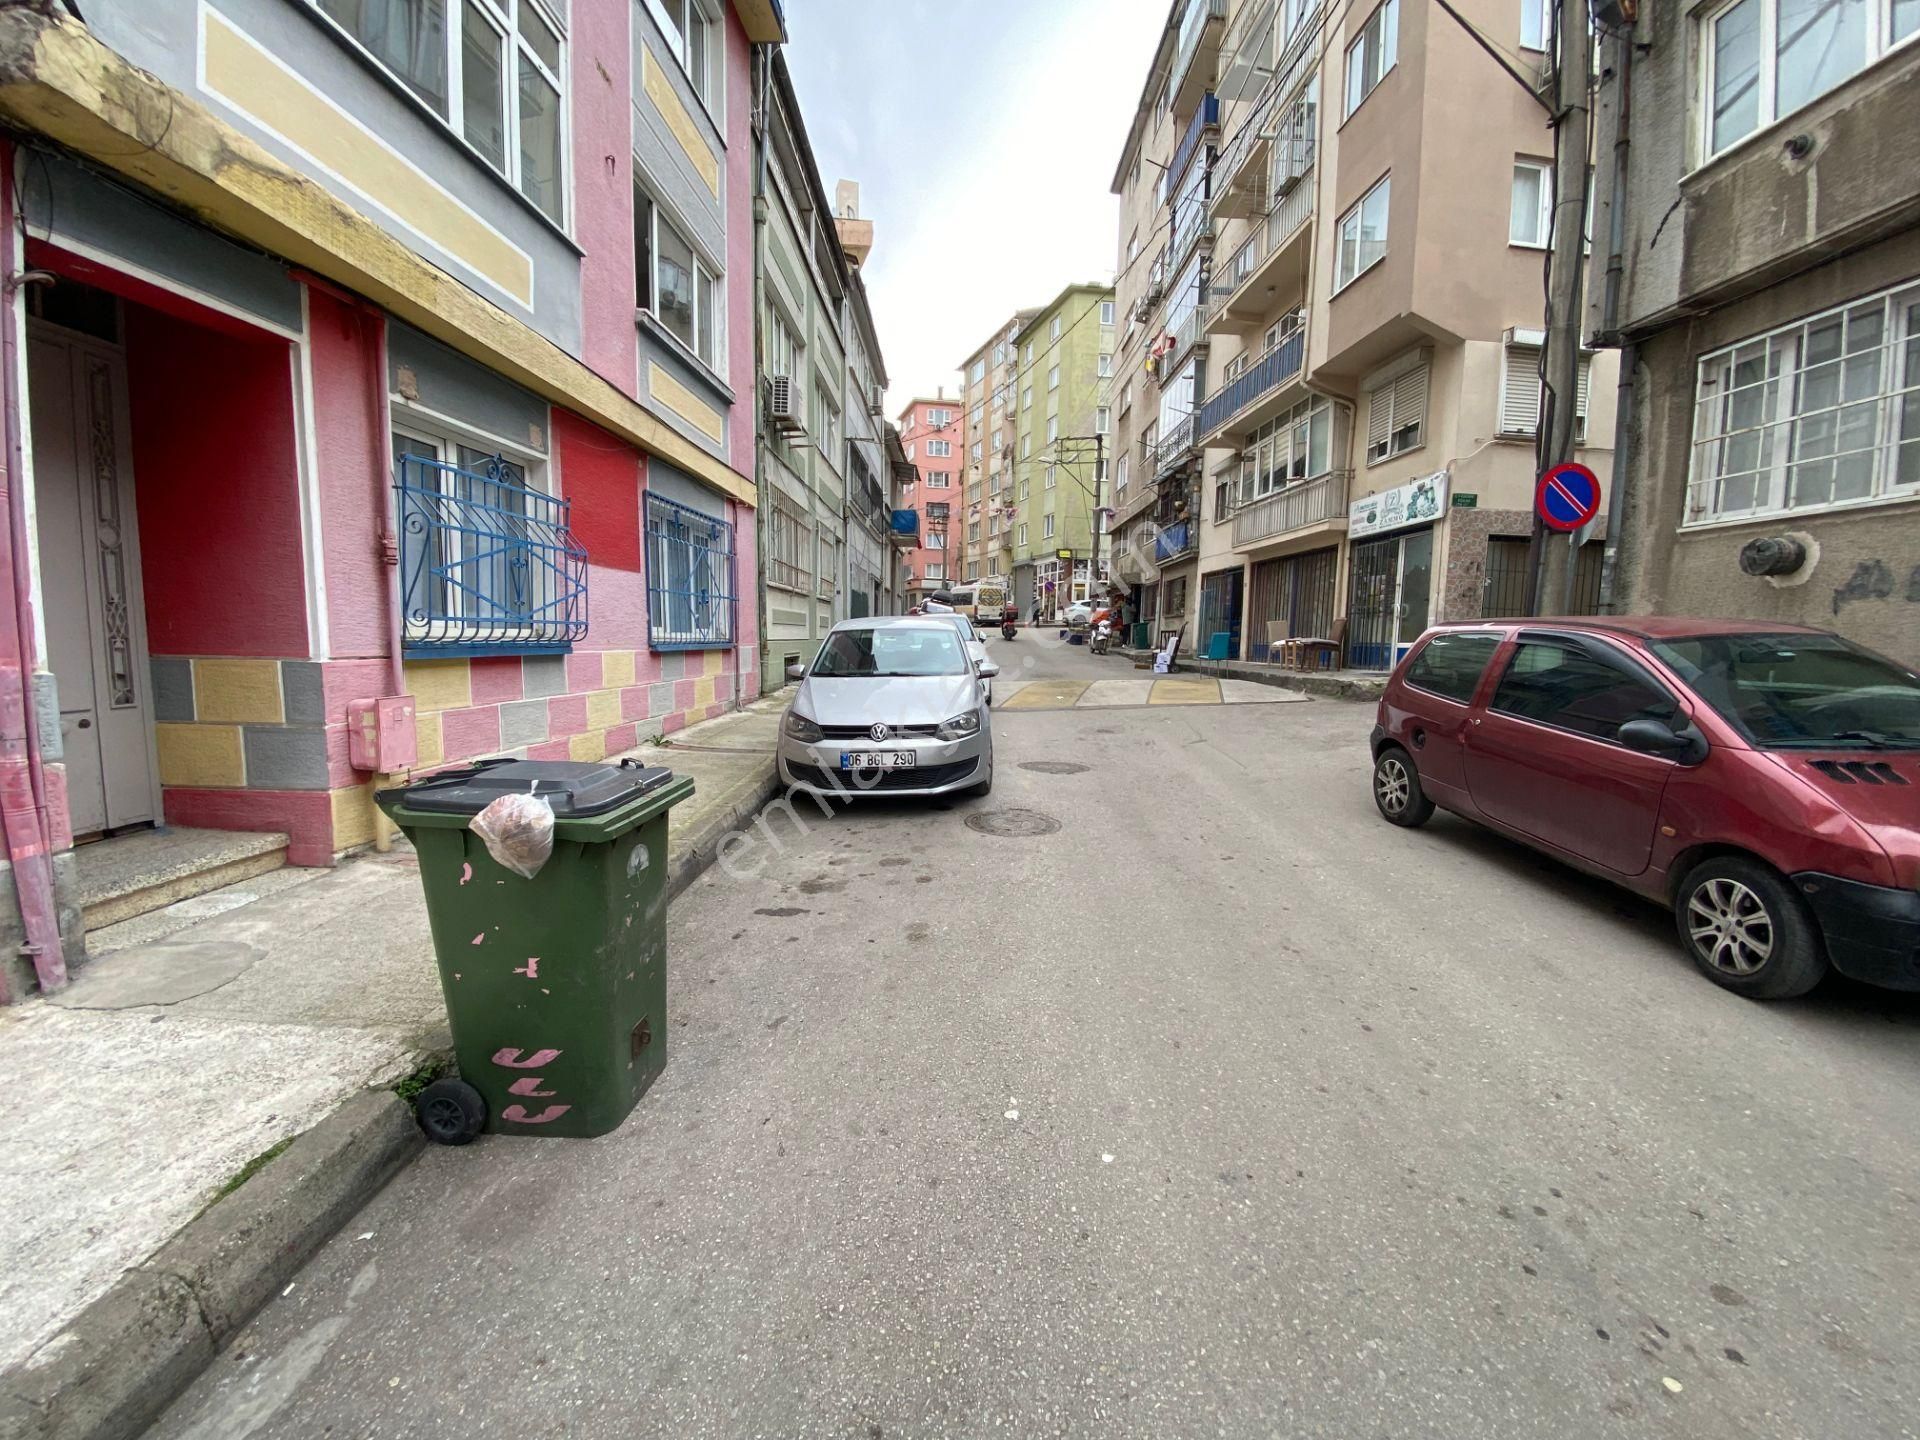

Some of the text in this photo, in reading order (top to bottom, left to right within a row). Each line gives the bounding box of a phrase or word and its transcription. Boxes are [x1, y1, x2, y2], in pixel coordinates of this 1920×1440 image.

[848, 753, 913, 766] 06 BGL 290
